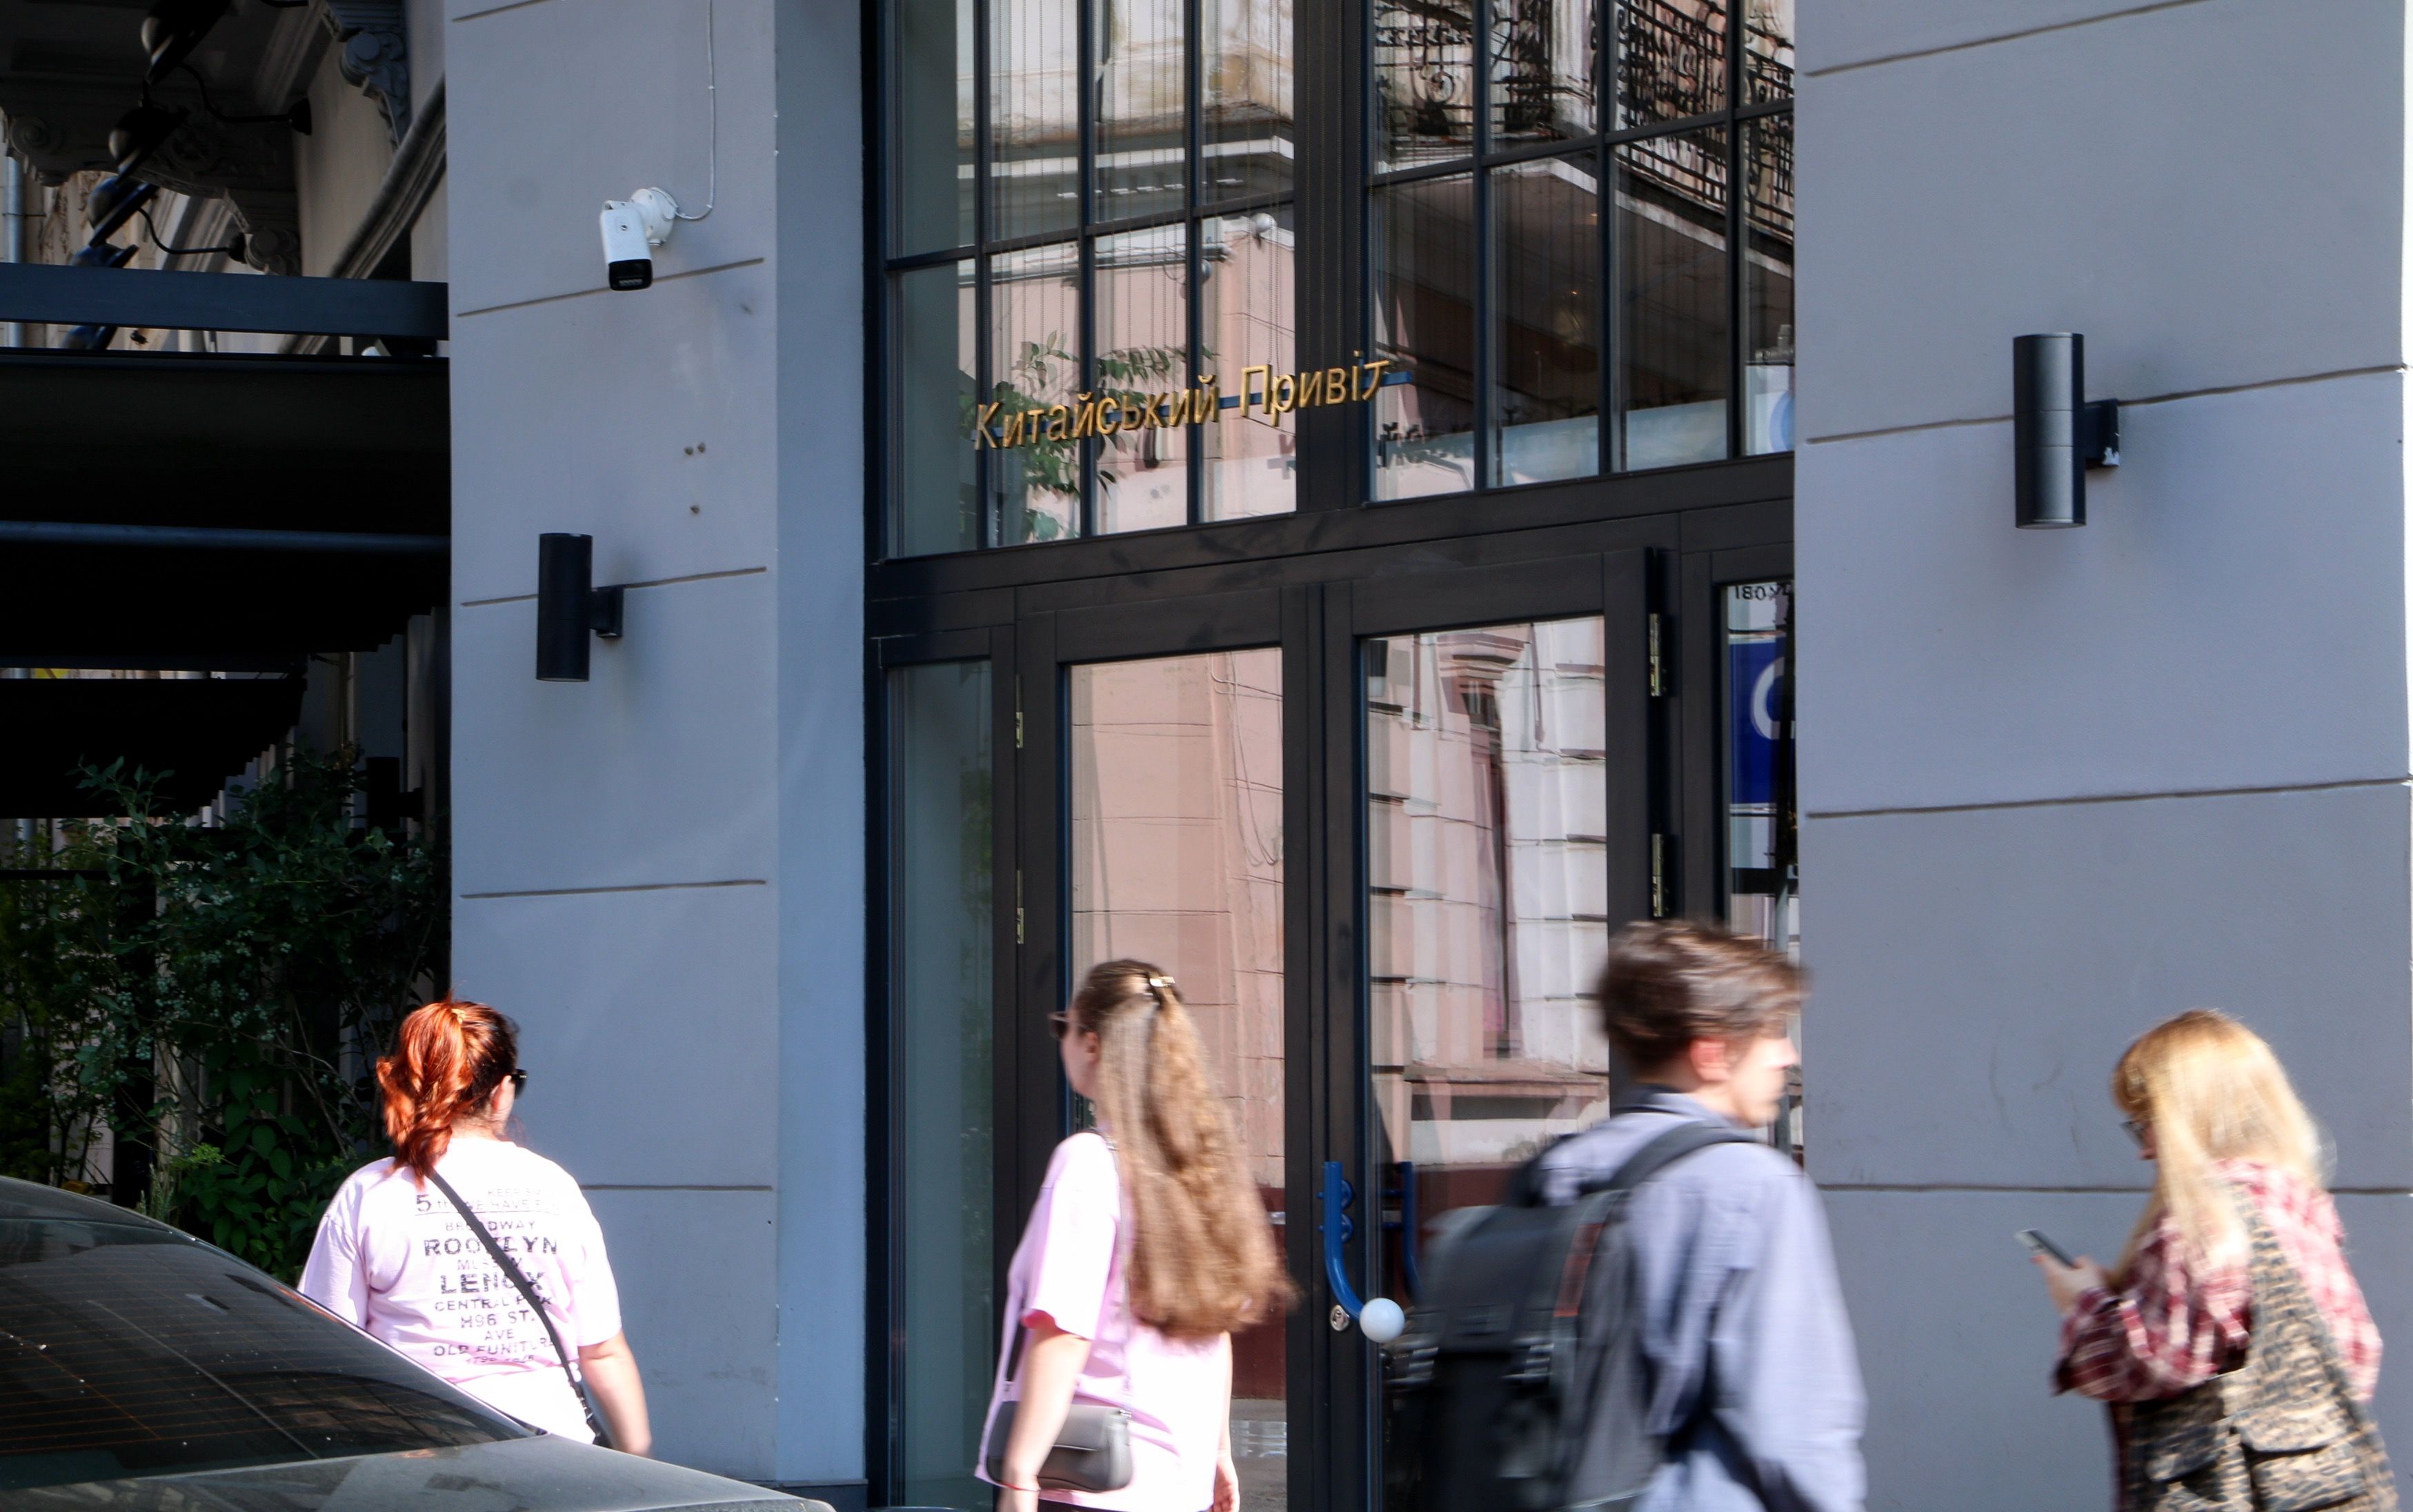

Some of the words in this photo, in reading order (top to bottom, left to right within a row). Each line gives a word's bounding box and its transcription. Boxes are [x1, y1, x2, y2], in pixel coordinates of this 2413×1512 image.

[974, 375, 1219, 450] Китайський
[1240, 350, 1391, 426] Привіт
[416, 1193, 432, 1212] 5
[446, 1220, 535, 1231] BRDWAY
[424, 1236, 557, 1257] ROOLYN
[484, 1329, 515, 1341] AVE
